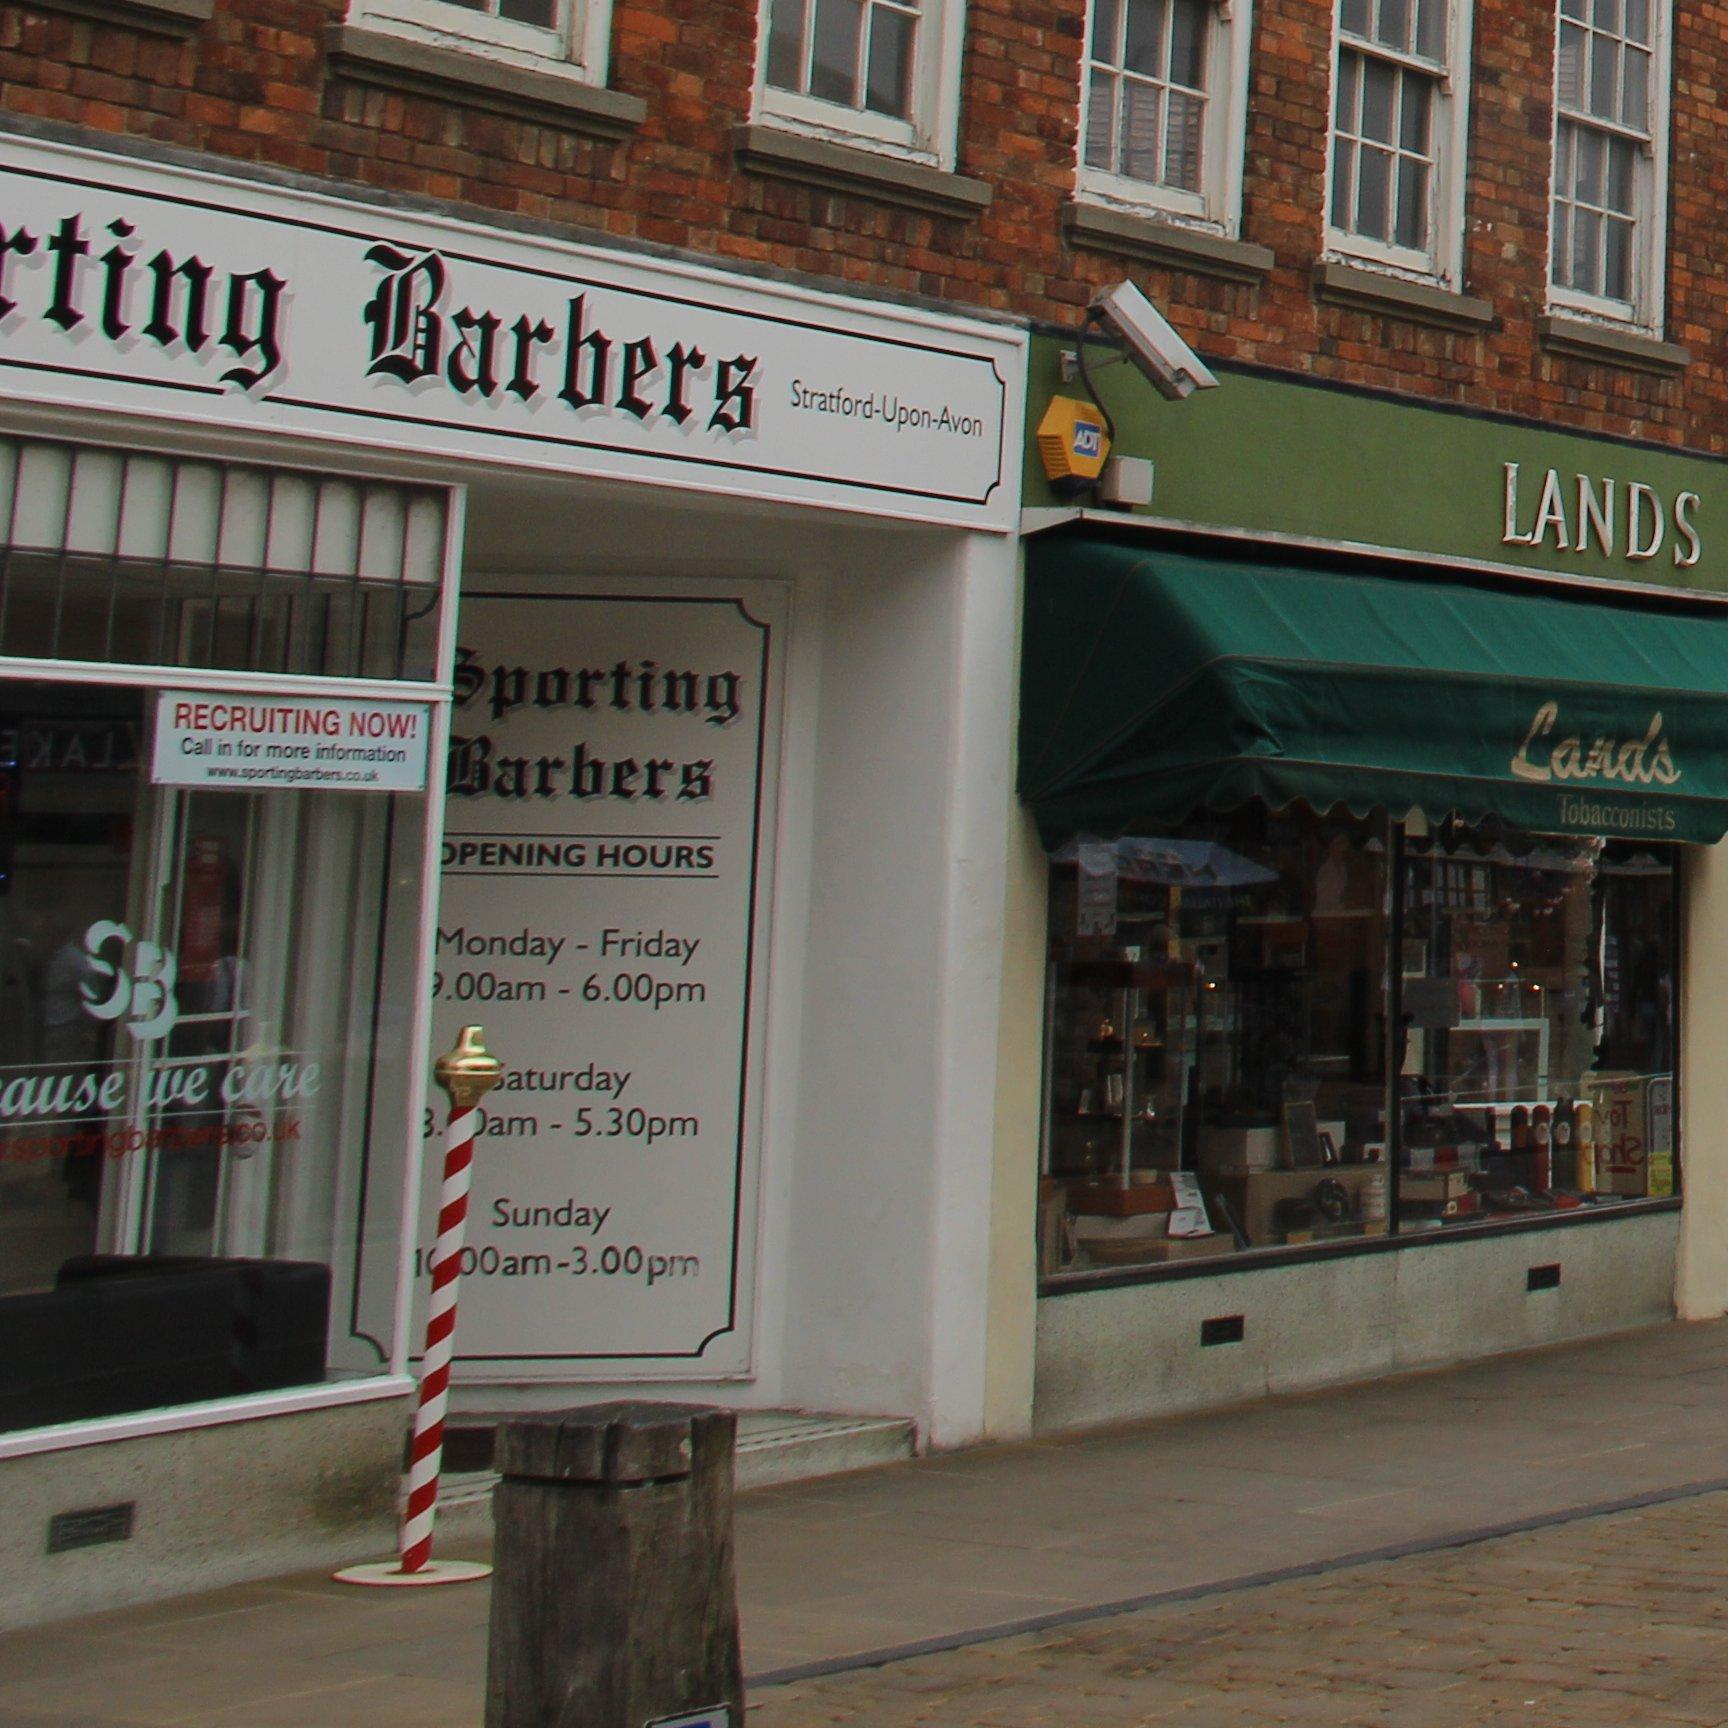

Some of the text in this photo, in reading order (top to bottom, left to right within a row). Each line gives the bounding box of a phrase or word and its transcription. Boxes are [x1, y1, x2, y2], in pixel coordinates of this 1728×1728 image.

[362, 241, 762, 433] Barbers
[791, 379, 984, 439] Stratford-Upon-Avon
[1073, 429, 1101, 451] ADT
[1502, 462, 1701, 567] LANDS
[453, 646, 744, 725] Sporting
[174, 702, 417, 739] RECRUITING NOW!
[181, 736, 407, 762] Call in for more information
[1511, 701, 1682, 785] Lands
[207, 766, 380, 784] www.sportingbarbers.co.uk
[447, 734, 715, 802] Barbers
[1556, 793, 1676, 830] Tobacconists
[441, 842, 714, 869] OPENING HOURS
[435, 927, 566, 965] Monday
[602, 929, 701, 967] Friday
[583, 973, 706, 1010] 6.00pm
[146, 1065, 210, 1107] we
[222, 1061, 321, 1104] care
[575, 1107, 699, 1145] 5.30pm
[492, 1198, 612, 1235] Sunday
